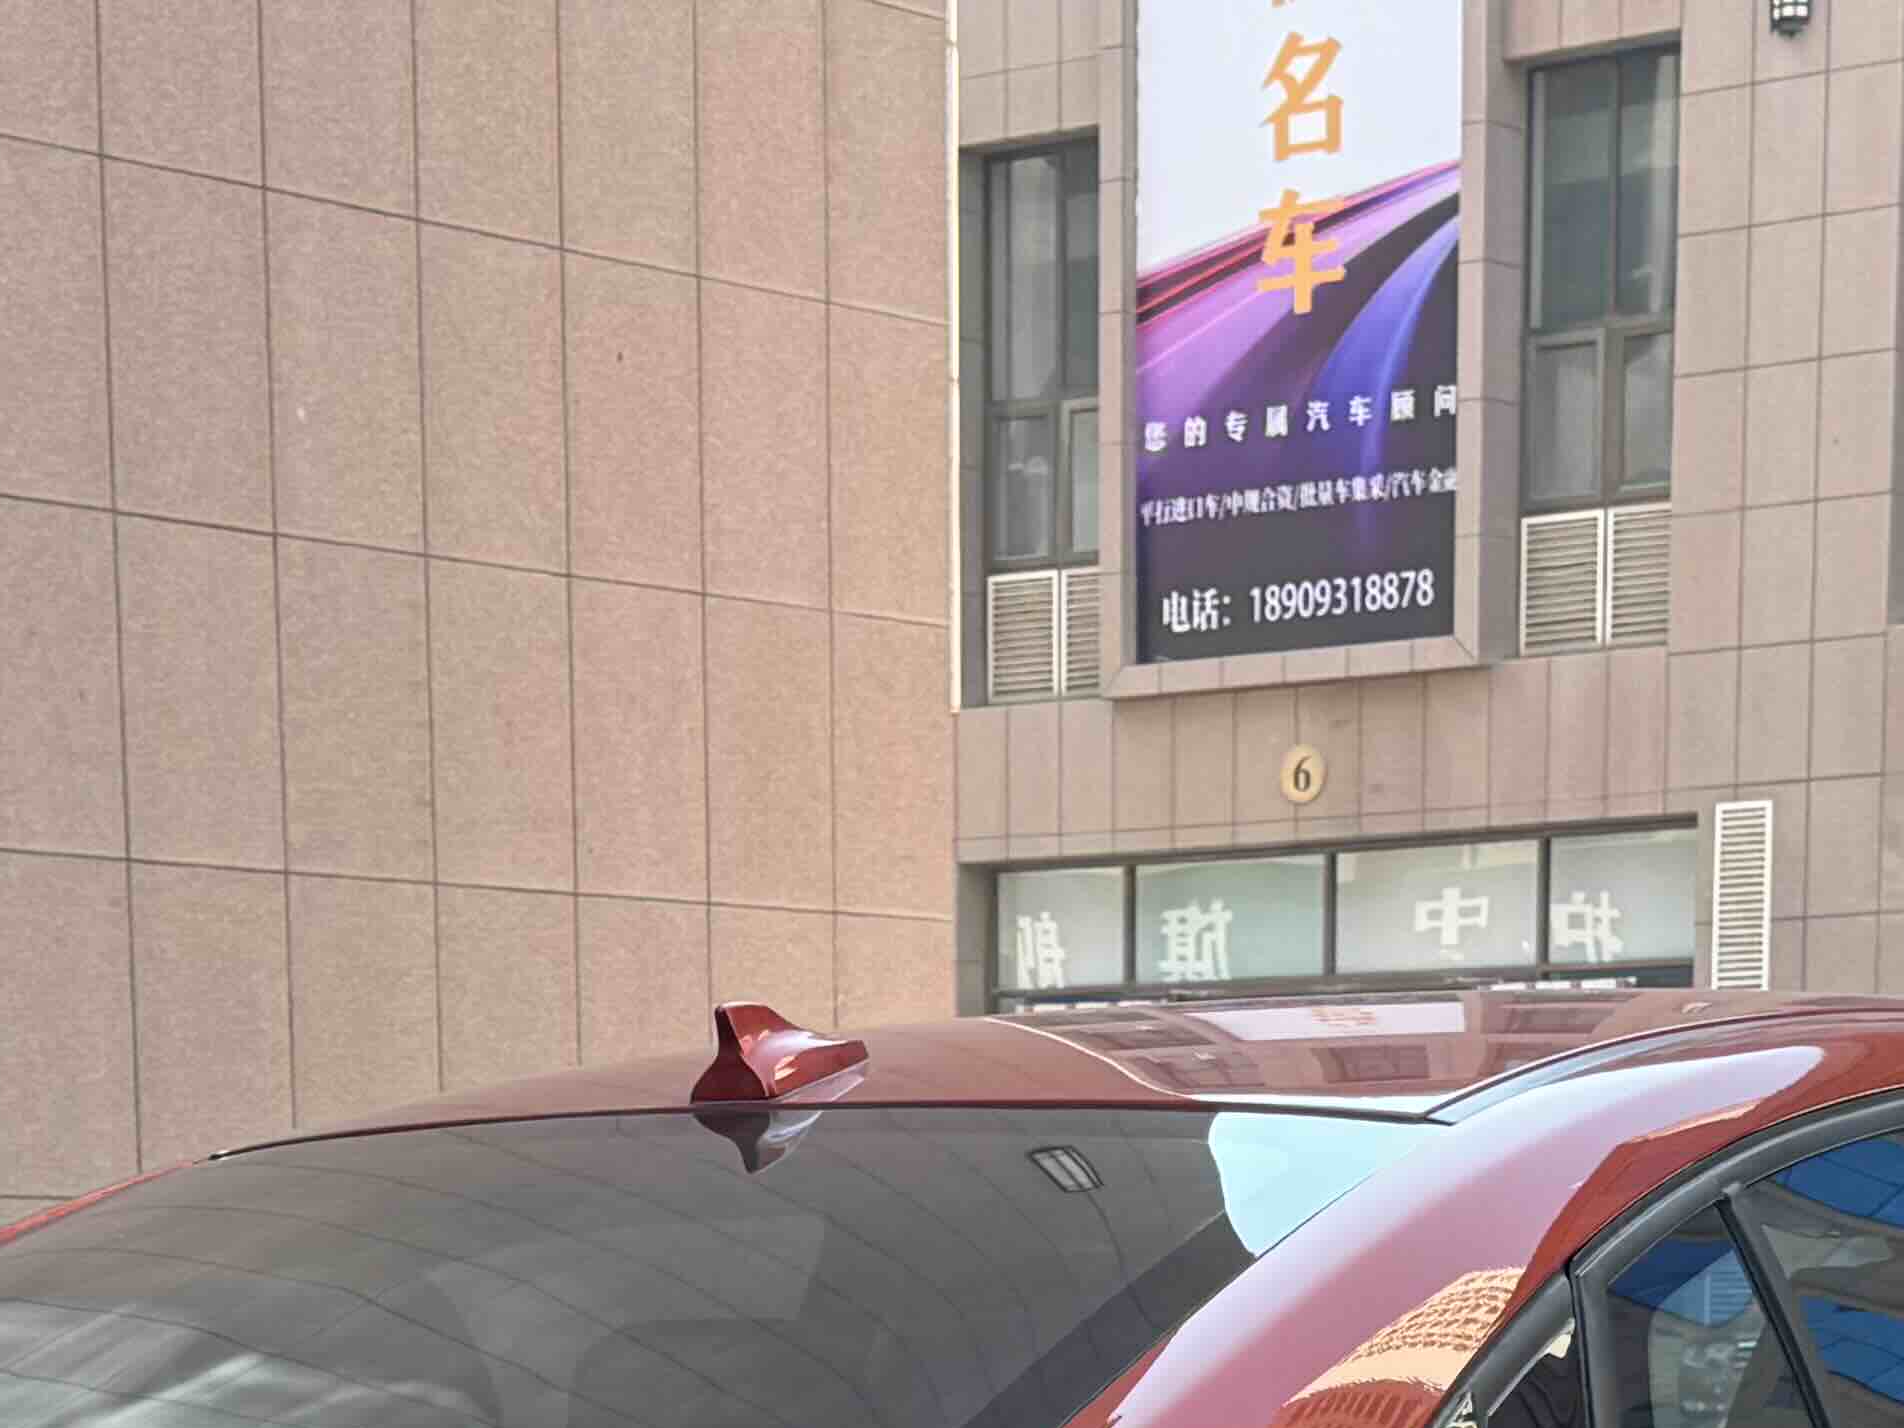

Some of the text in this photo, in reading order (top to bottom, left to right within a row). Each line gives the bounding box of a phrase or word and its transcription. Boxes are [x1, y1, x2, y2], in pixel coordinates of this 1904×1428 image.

[1256, 0, 1346, 315] 名车
[1249, 567, 1435, 624] 18909318878
[1292, 754, 1315, 794] 6
